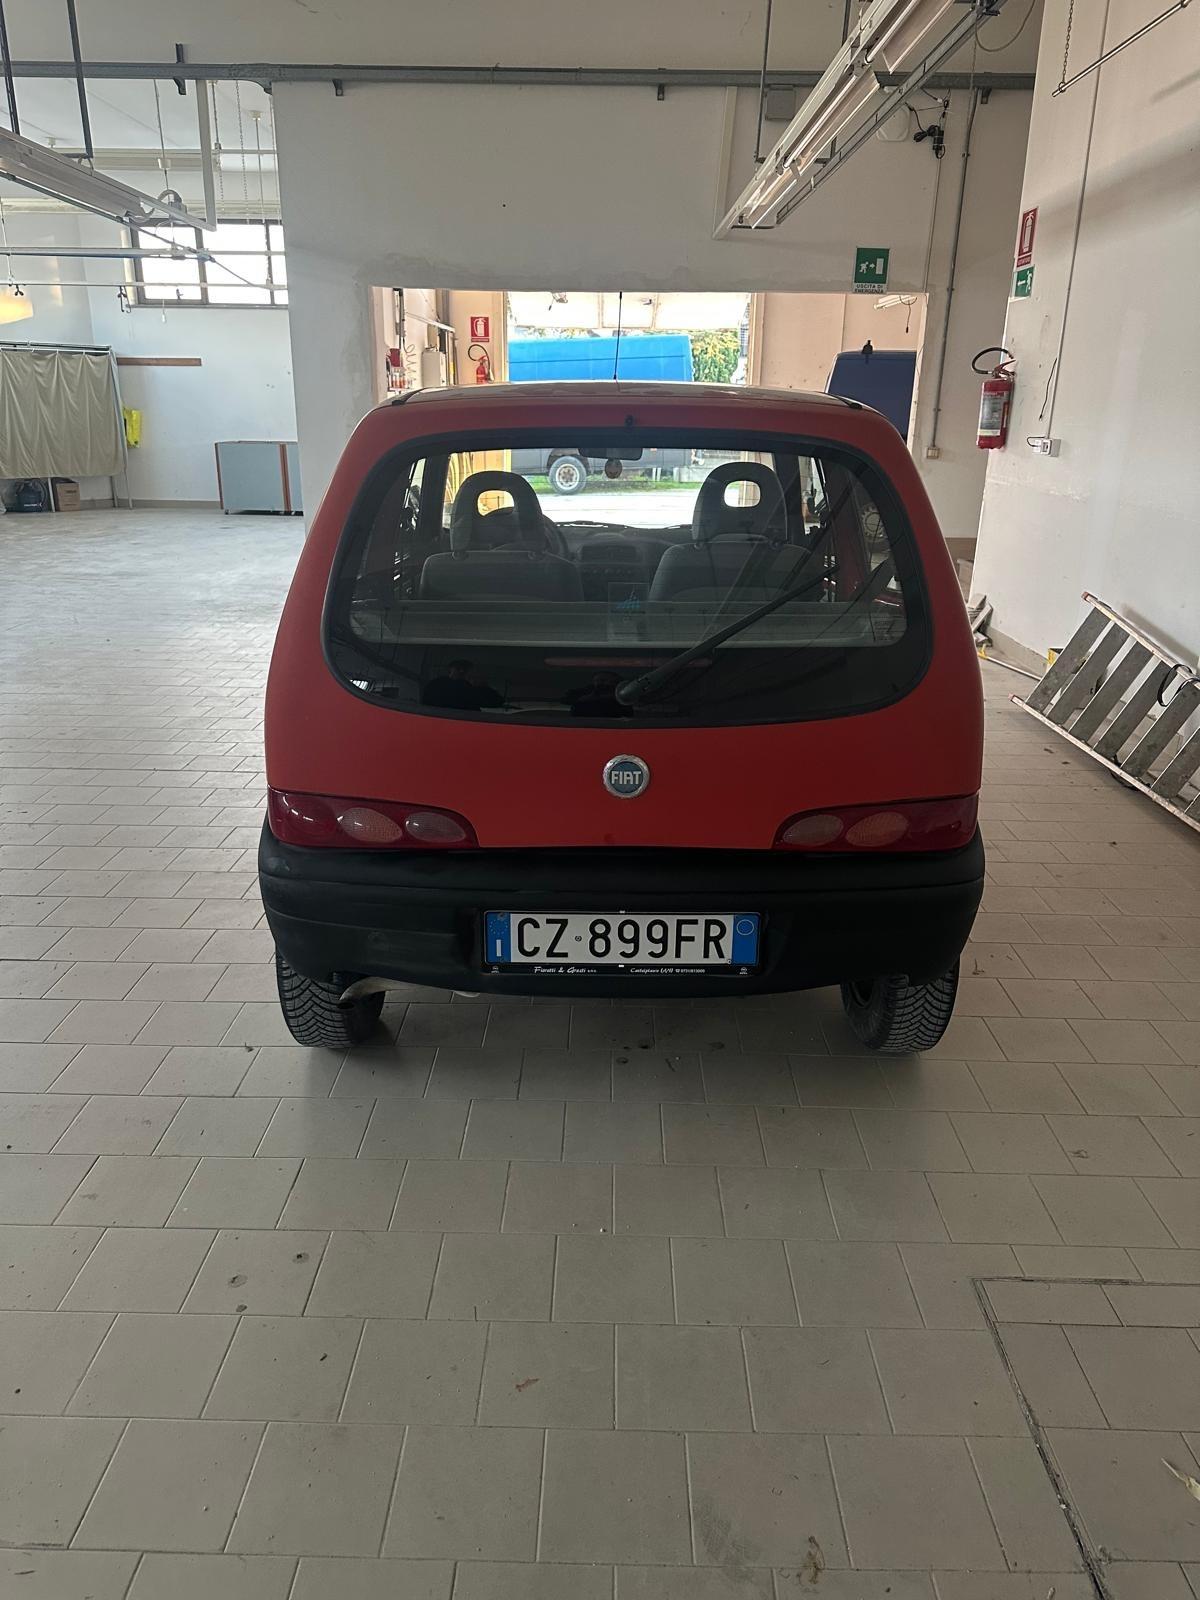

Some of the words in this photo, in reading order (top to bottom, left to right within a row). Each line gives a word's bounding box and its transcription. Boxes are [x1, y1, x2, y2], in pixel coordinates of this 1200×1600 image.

[611, 770, 642, 785] FIAT
[517, 917, 569, 958] CZ
[588, 918, 727, 959] 899FR
